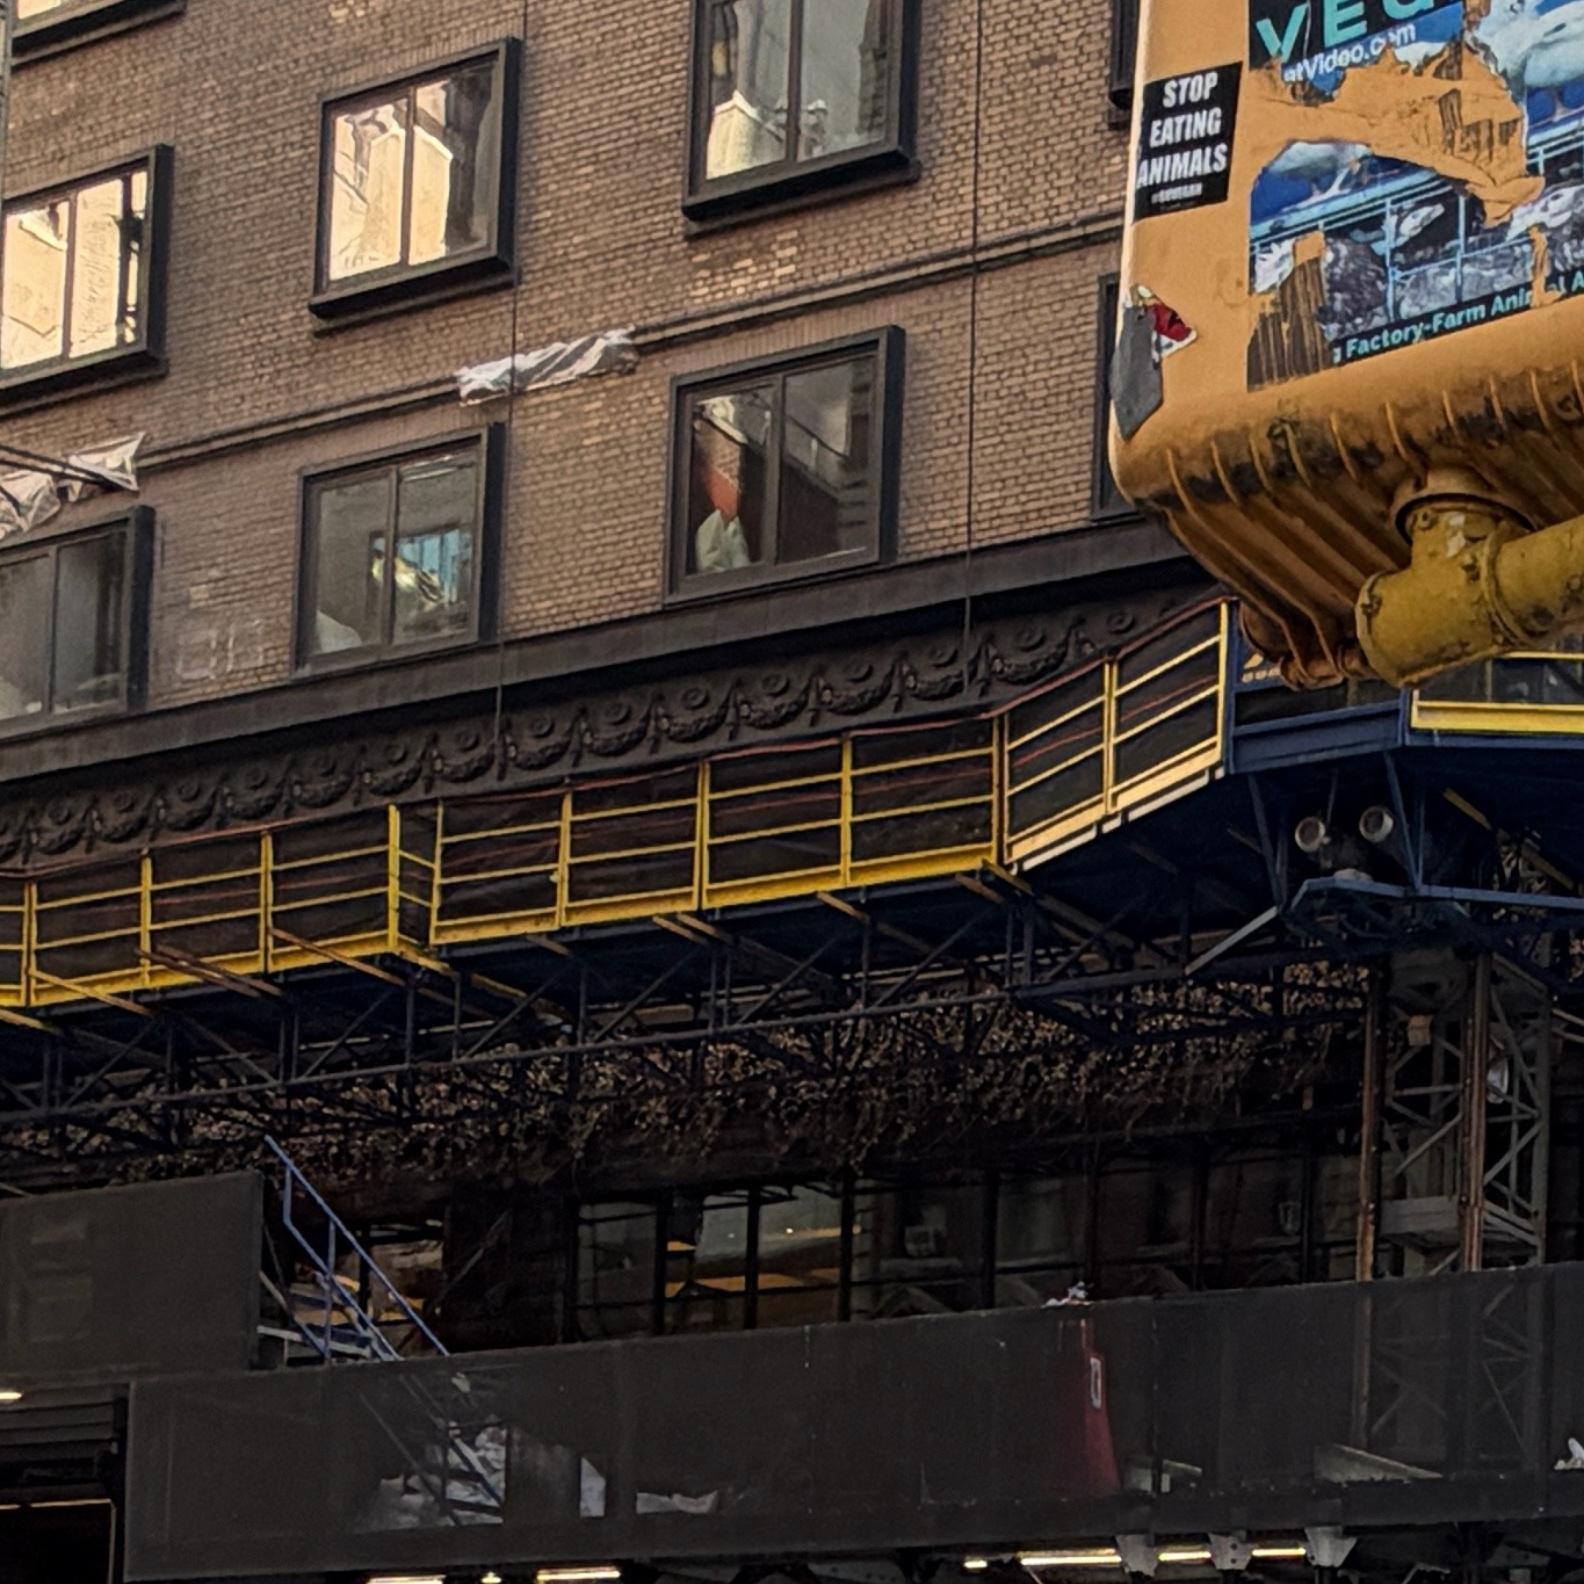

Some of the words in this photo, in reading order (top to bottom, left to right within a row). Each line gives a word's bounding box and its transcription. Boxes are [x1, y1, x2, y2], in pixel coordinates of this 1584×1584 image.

[1162, 71, 1219, 108] STOP
[1150, 107, 1221, 149] EATING
[1136, 143, 1228, 189] ANIMALS
[1346, 303, 1486, 360] Factory-Farm
